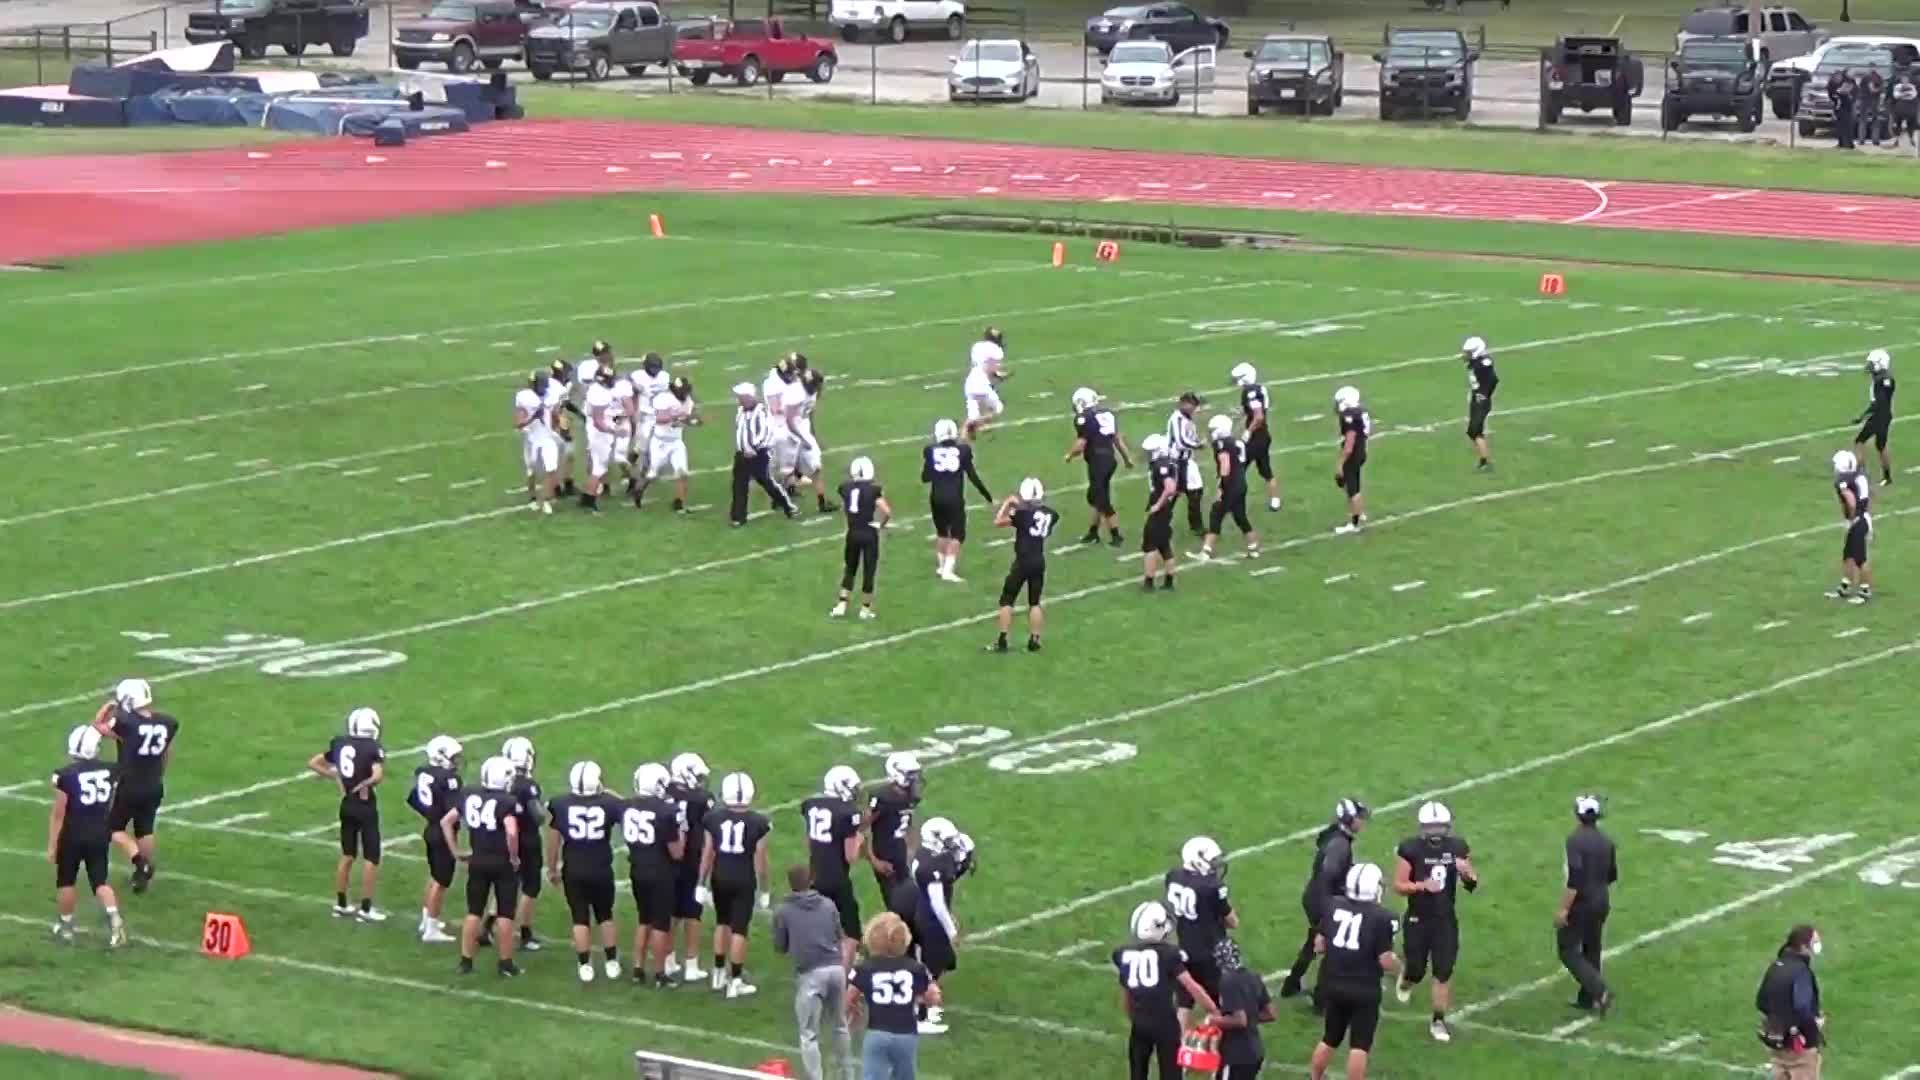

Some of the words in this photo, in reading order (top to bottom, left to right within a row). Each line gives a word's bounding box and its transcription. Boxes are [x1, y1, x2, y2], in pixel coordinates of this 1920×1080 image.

[849, 492, 860, 514] 1
[1029, 511, 1052, 537] 31
[138, 724, 168, 756] 73
[339, 745, 356, 778] 6
[78, 769, 111, 805] 55
[465, 794, 498, 830] 64
[567, 805, 606, 840] 52
[623, 807, 656, 844] 65
[808, 806, 833, 843] 12
[719, 819, 745, 853] 11
[1166, 881, 1198, 921] 50
[206, 918, 232, 952] 30
[1332, 909, 1361, 950] 71
[1122, 949, 1159, 988] 70
[871, 969, 913, 1005] 53
